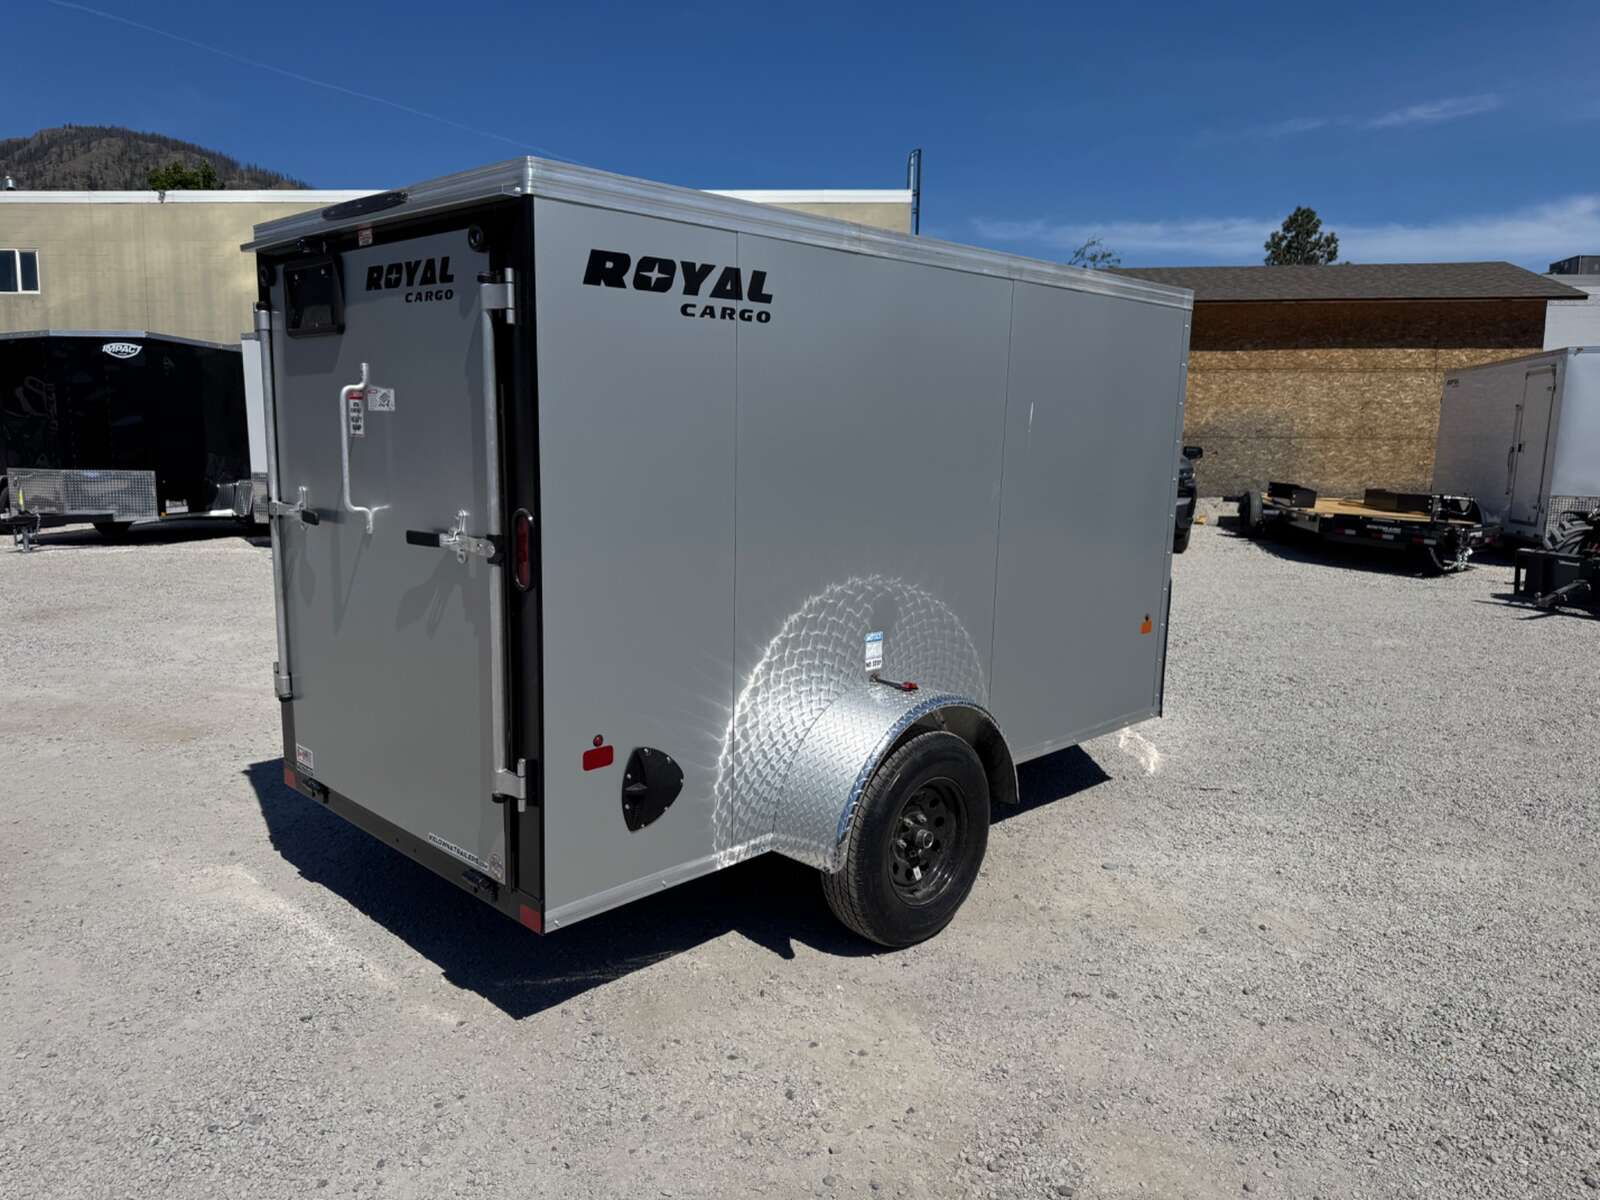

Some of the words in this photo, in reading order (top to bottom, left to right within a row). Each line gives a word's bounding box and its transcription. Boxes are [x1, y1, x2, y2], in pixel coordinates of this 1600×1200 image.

[366, 256, 454, 291] ROYAL
[582, 249, 773, 304] ROYAL
[405, 289, 454, 303] CARGO
[680, 303, 771, 323] CARGO
